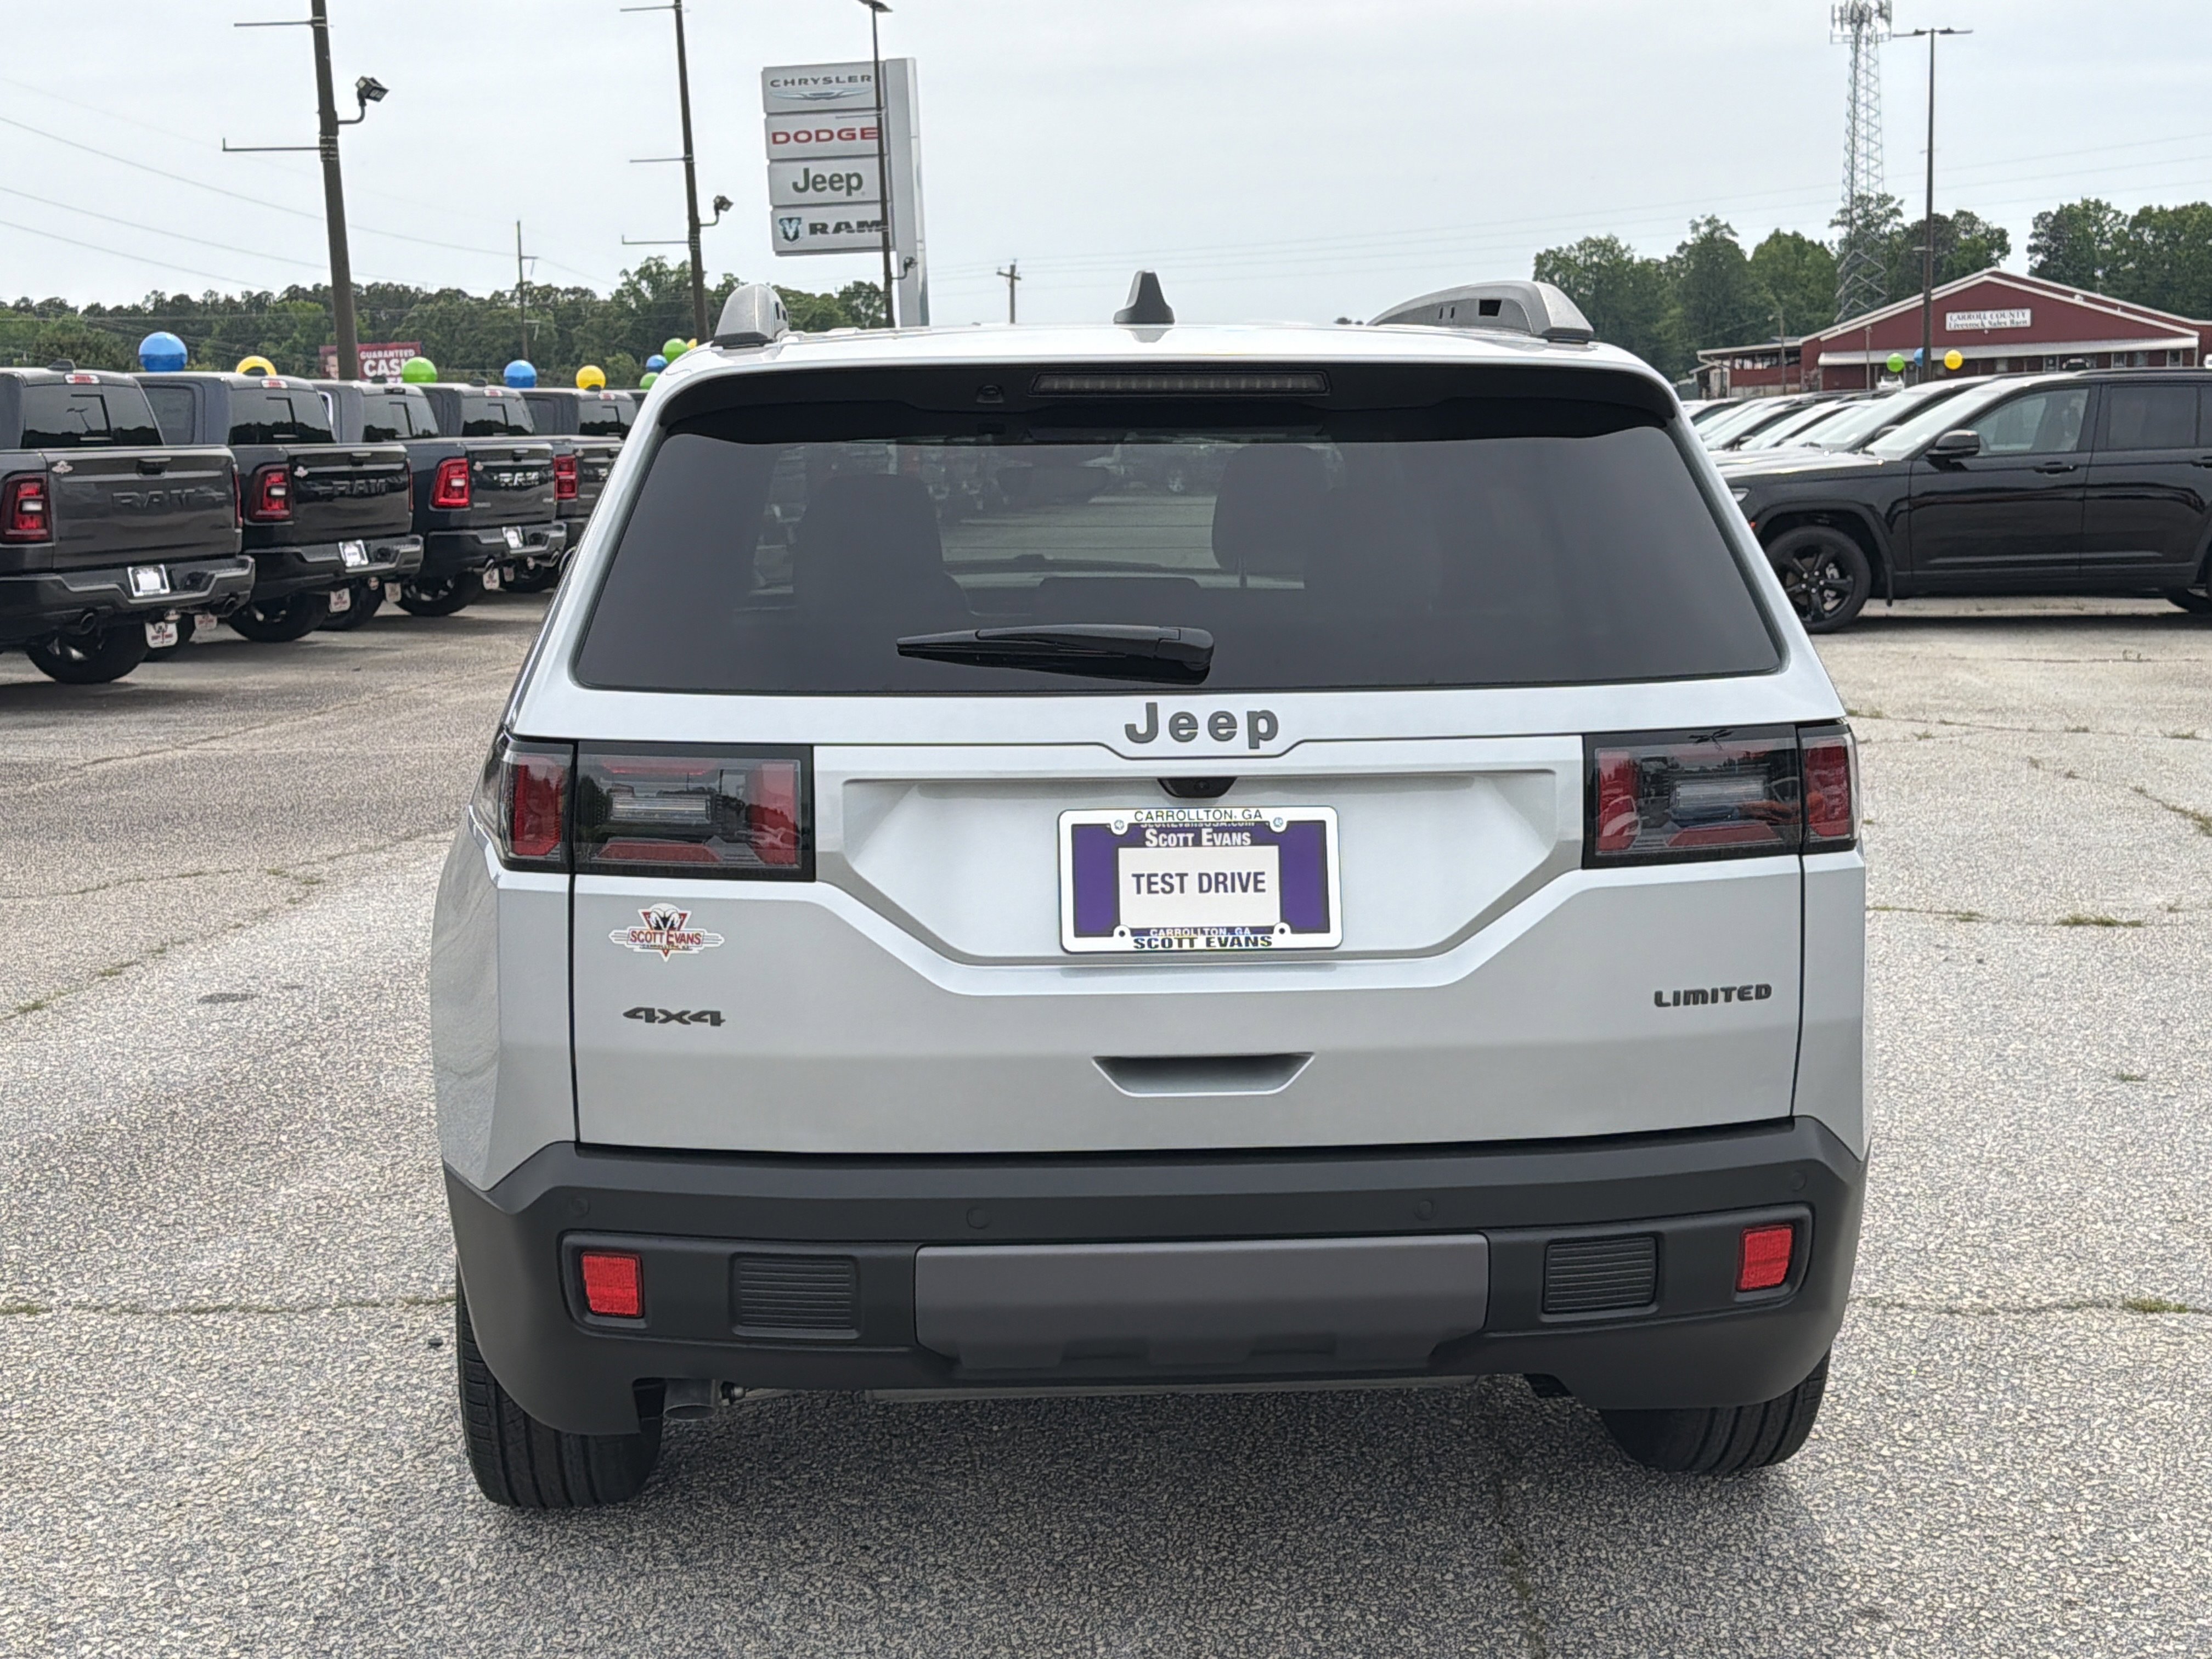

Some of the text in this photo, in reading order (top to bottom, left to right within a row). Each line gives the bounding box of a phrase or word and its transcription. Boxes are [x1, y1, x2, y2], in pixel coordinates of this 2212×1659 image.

[770, 75, 872, 88] CHRYSLER
[771, 127, 879, 145] DODGE
[792, 168, 863, 196] Jeep
[808, 220, 883, 235] RAM
[359, 349, 415, 360] GUARANTEED
[1124, 702, 1279, 749] Jeep
[1242, 809, 1263, 820] GA
[1131, 871, 1266, 895] TEST DRIVE
[630, 930, 702, 945] SCOTT EVANS
[1234, 927, 1251, 935] GA
[1133, 935, 1273, 949] SCOTT EVANS
[1654, 983, 1773, 1007] LIMITED
